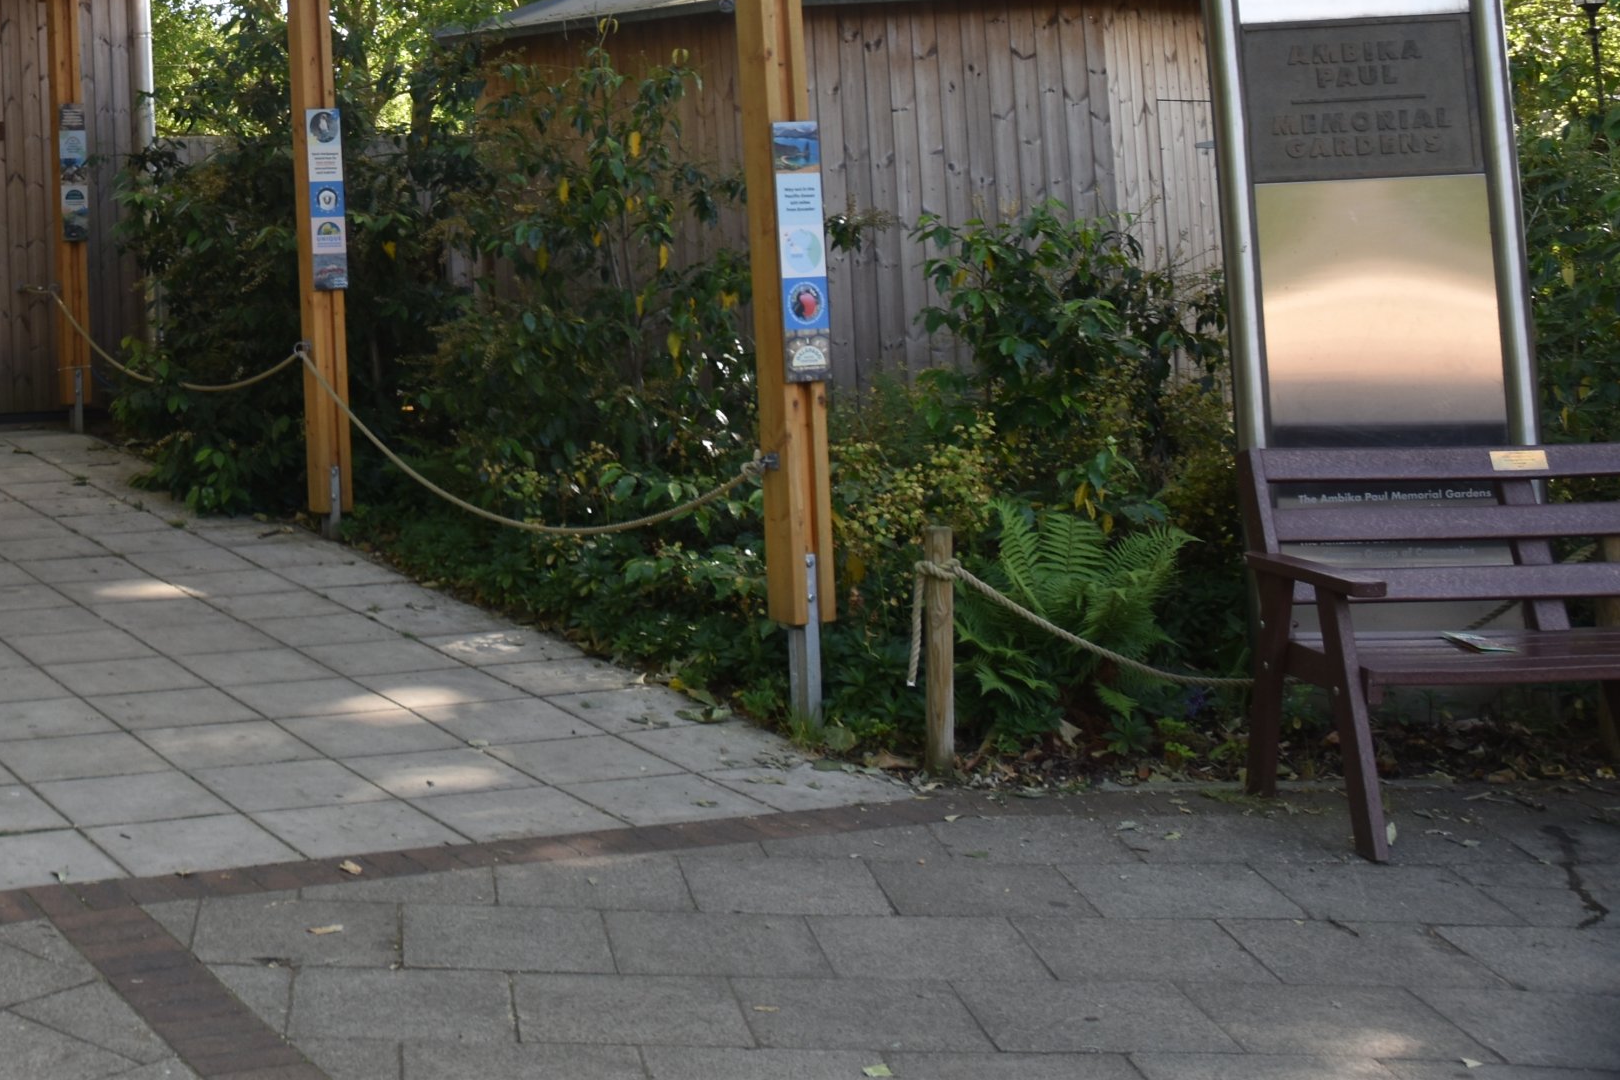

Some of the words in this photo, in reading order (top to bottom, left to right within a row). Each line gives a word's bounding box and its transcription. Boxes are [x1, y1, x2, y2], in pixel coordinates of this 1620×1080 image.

[1287, 39, 1423, 66] AMBIKA
[1315, 64, 1399, 89] PAUL
[1271, 107, 1453, 136] MEMORIAL
[1285, 133, 1441, 159] GARDENS
[1298, 495, 1317, 505] The
[1320, 493, 1362, 503] Ambika
[1365, 491, 1388, 501] Paul
[1391, 489, 1443, 500] Memorial
[1445, 488, 1492, 499] Gardens
